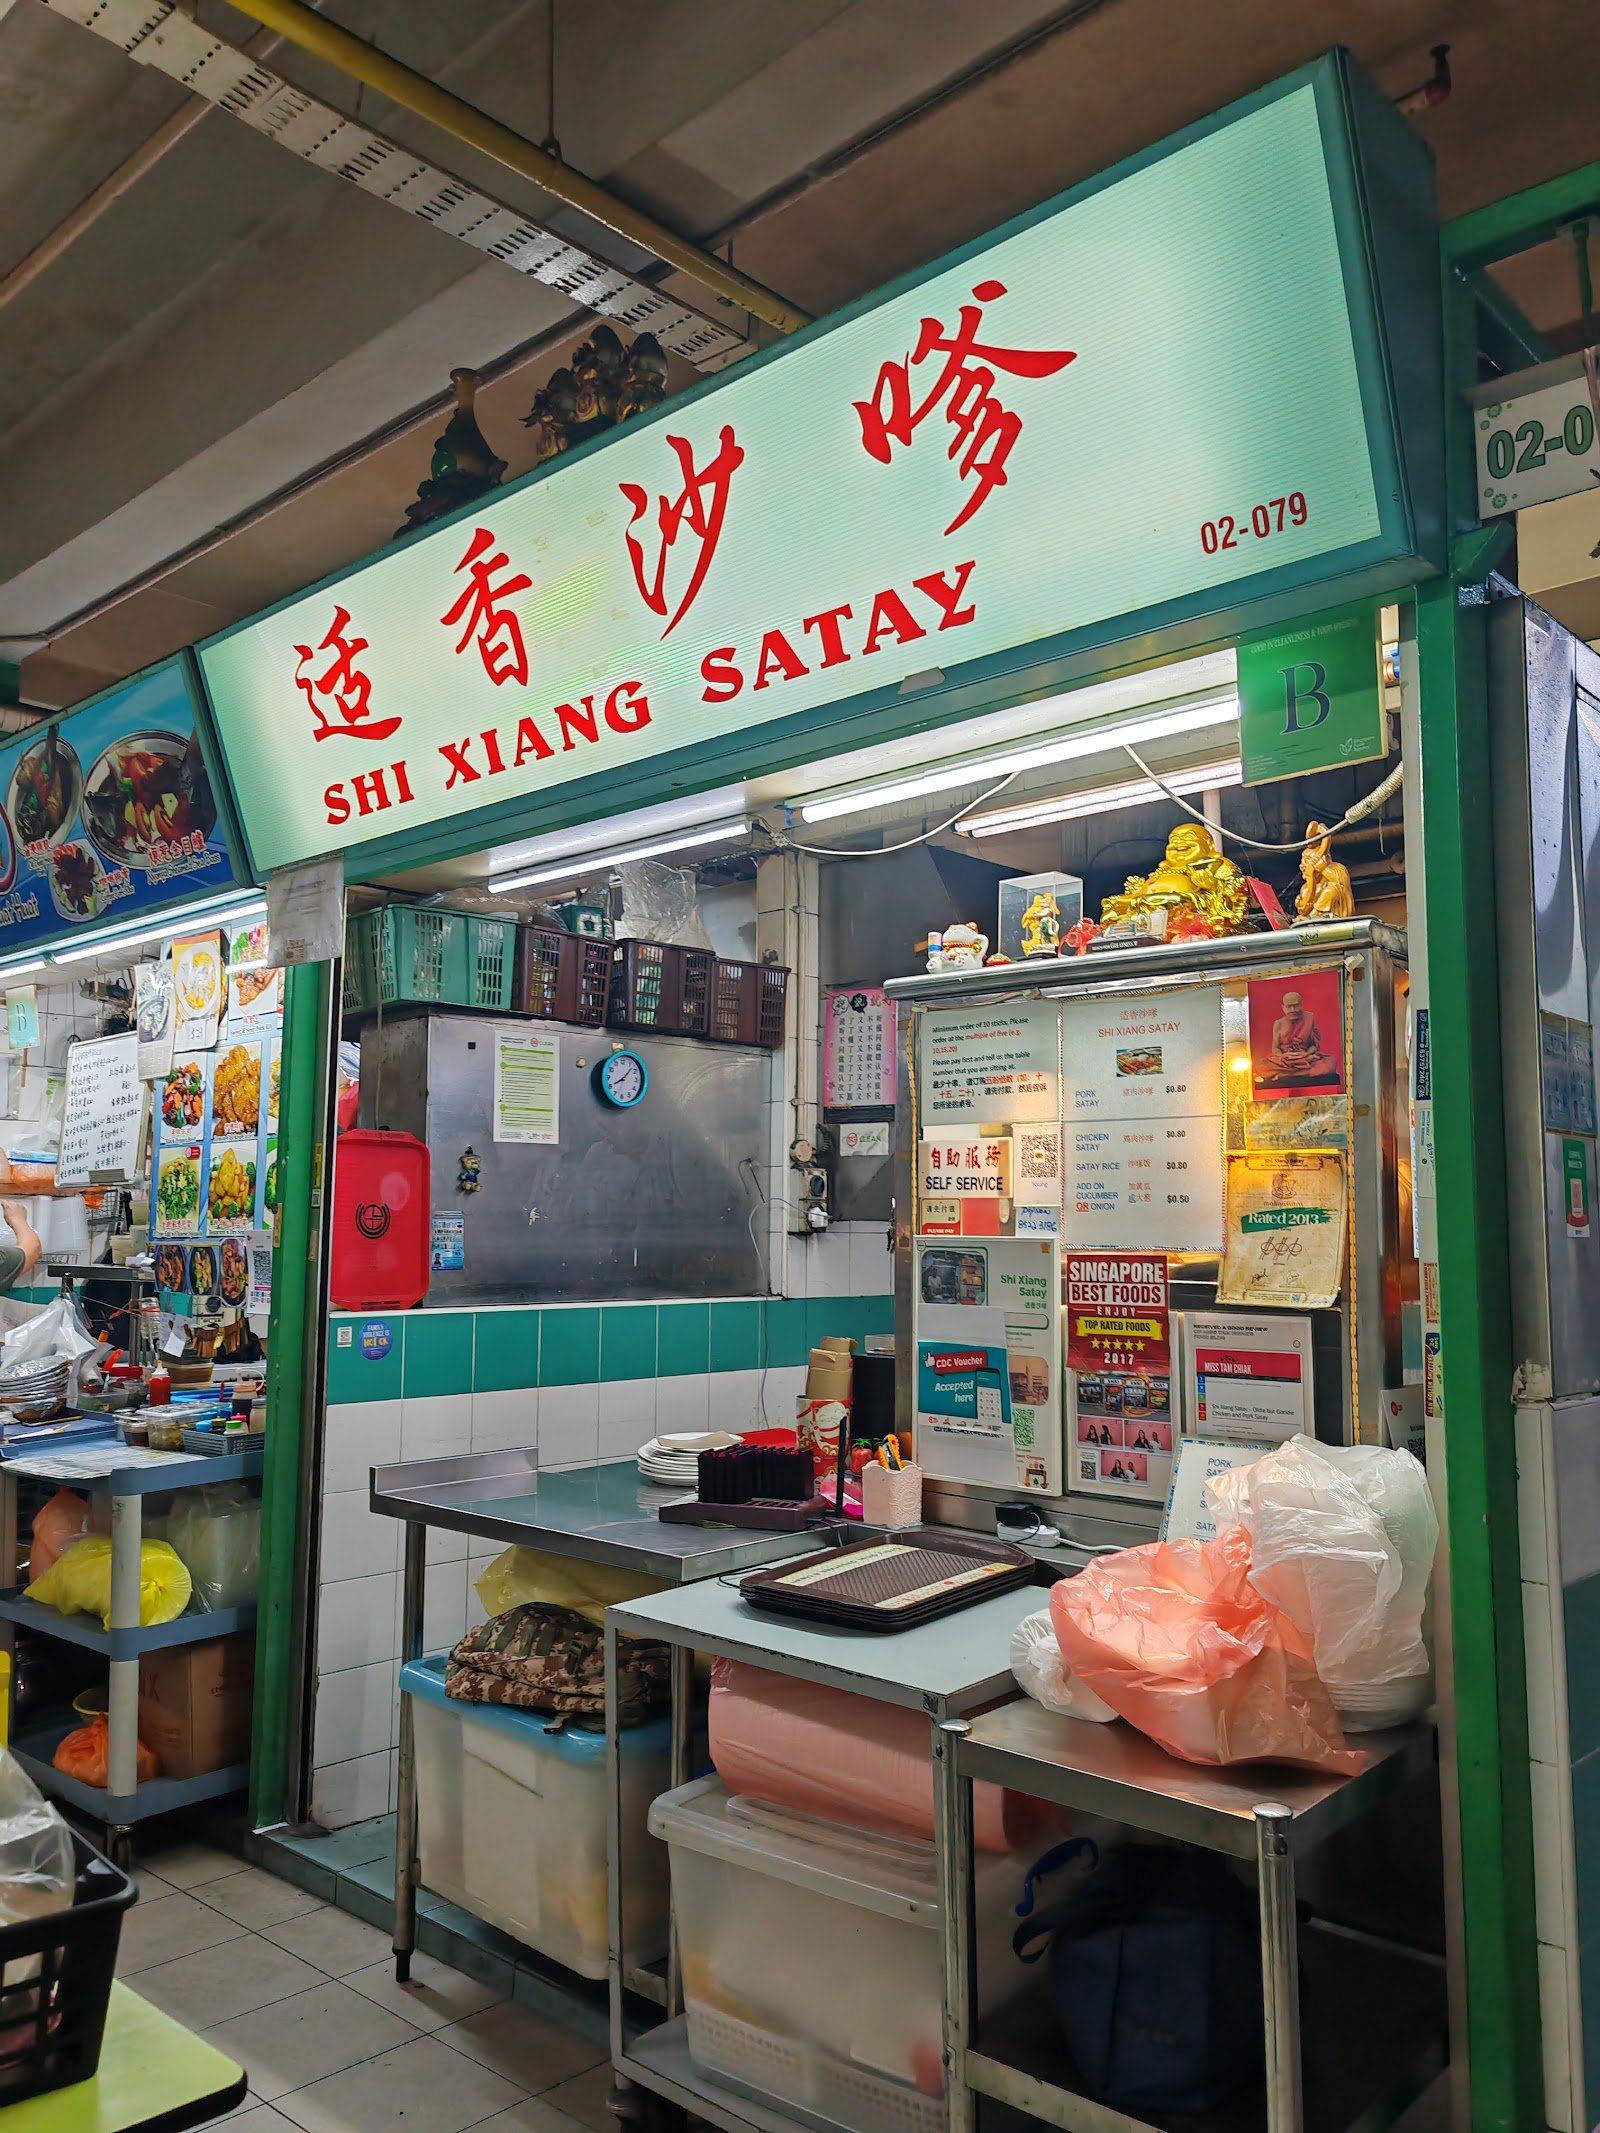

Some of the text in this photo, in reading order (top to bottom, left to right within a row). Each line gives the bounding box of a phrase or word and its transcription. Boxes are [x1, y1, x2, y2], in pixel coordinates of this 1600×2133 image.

[1200, 492, 1308, 554] 02-079
[323, 560, 976, 824] SHI XIANG SATAY
[1280, 661, 1330, 736] B
[932, 1025, 958, 1033] Minimum
[960, 1022, 975, 1030] order
[1010, 1017, 1029, 1025] Please
[1098, 1022, 1181, 1038] SHI XIANG SATAY
[965, 1031, 989, 1040] multiple
[990, 1030, 996, 1038] of
[933, 1058, 949, 1066] Please
[951, 1058, 961, 1066] pay
[974, 1054, 985, 1062] and
[1015, 1051, 1030, 1059] table
[933, 1068, 953, 1077] number
[955, 1067, 966, 1075] that
[967, 1067, 978, 1075] you
[989, 1064, 1007, 1072] sitting
[1075, 1090, 1096, 1098] PORK
[1166, 1085, 1186, 1094] $0.80
[1075, 1100, 1100, 1108] SATAY
[1075, 1133, 1109, 1142] CHICKEN
[1166, 1130, 1186, 1139] $0.80
[1075, 1143, 1100, 1151] SATAY
[931, 1145, 1001, 1169] 自助服務
[1076, 1162, 1120, 1171] SATAY RICE
[1166, 1161, 1188, 1170] $0.80
[926, 1176, 1003, 1191] SELF SERVICE
[1076, 1191, 1119, 1200] CUCUMBER
[1167, 1195, 1189, 1204] $0.50
[1076, 1202, 1115, 1211] OR ONION
[1248, 1212, 1319, 1225] Rated 2013
[1069, 1261, 1165, 1283] SINGAPORE
[1000, 1275, 1046, 1287] Shi Xiang
[1019, 1287, 1047, 1299] Satay
[1072, 1284, 1161, 1303] BEST FOODS
[1097, 1306, 1136, 1317] ENJOY
[1084, 1320, 1151, 1332] TOP RATED FOODS
[936, 1357, 983, 1368] CDC Voucher
[1104, 1352, 1134, 1365] 2017
[1204, 1362, 1252, 1374] MISS TAM CHIAK
[934, 1380, 974, 1392] Accepted
[954, 1394, 974, 1403] here
[1235, 1405, 1248, 1413] Satay
[1208, 1458, 1232, 1468] PORK
